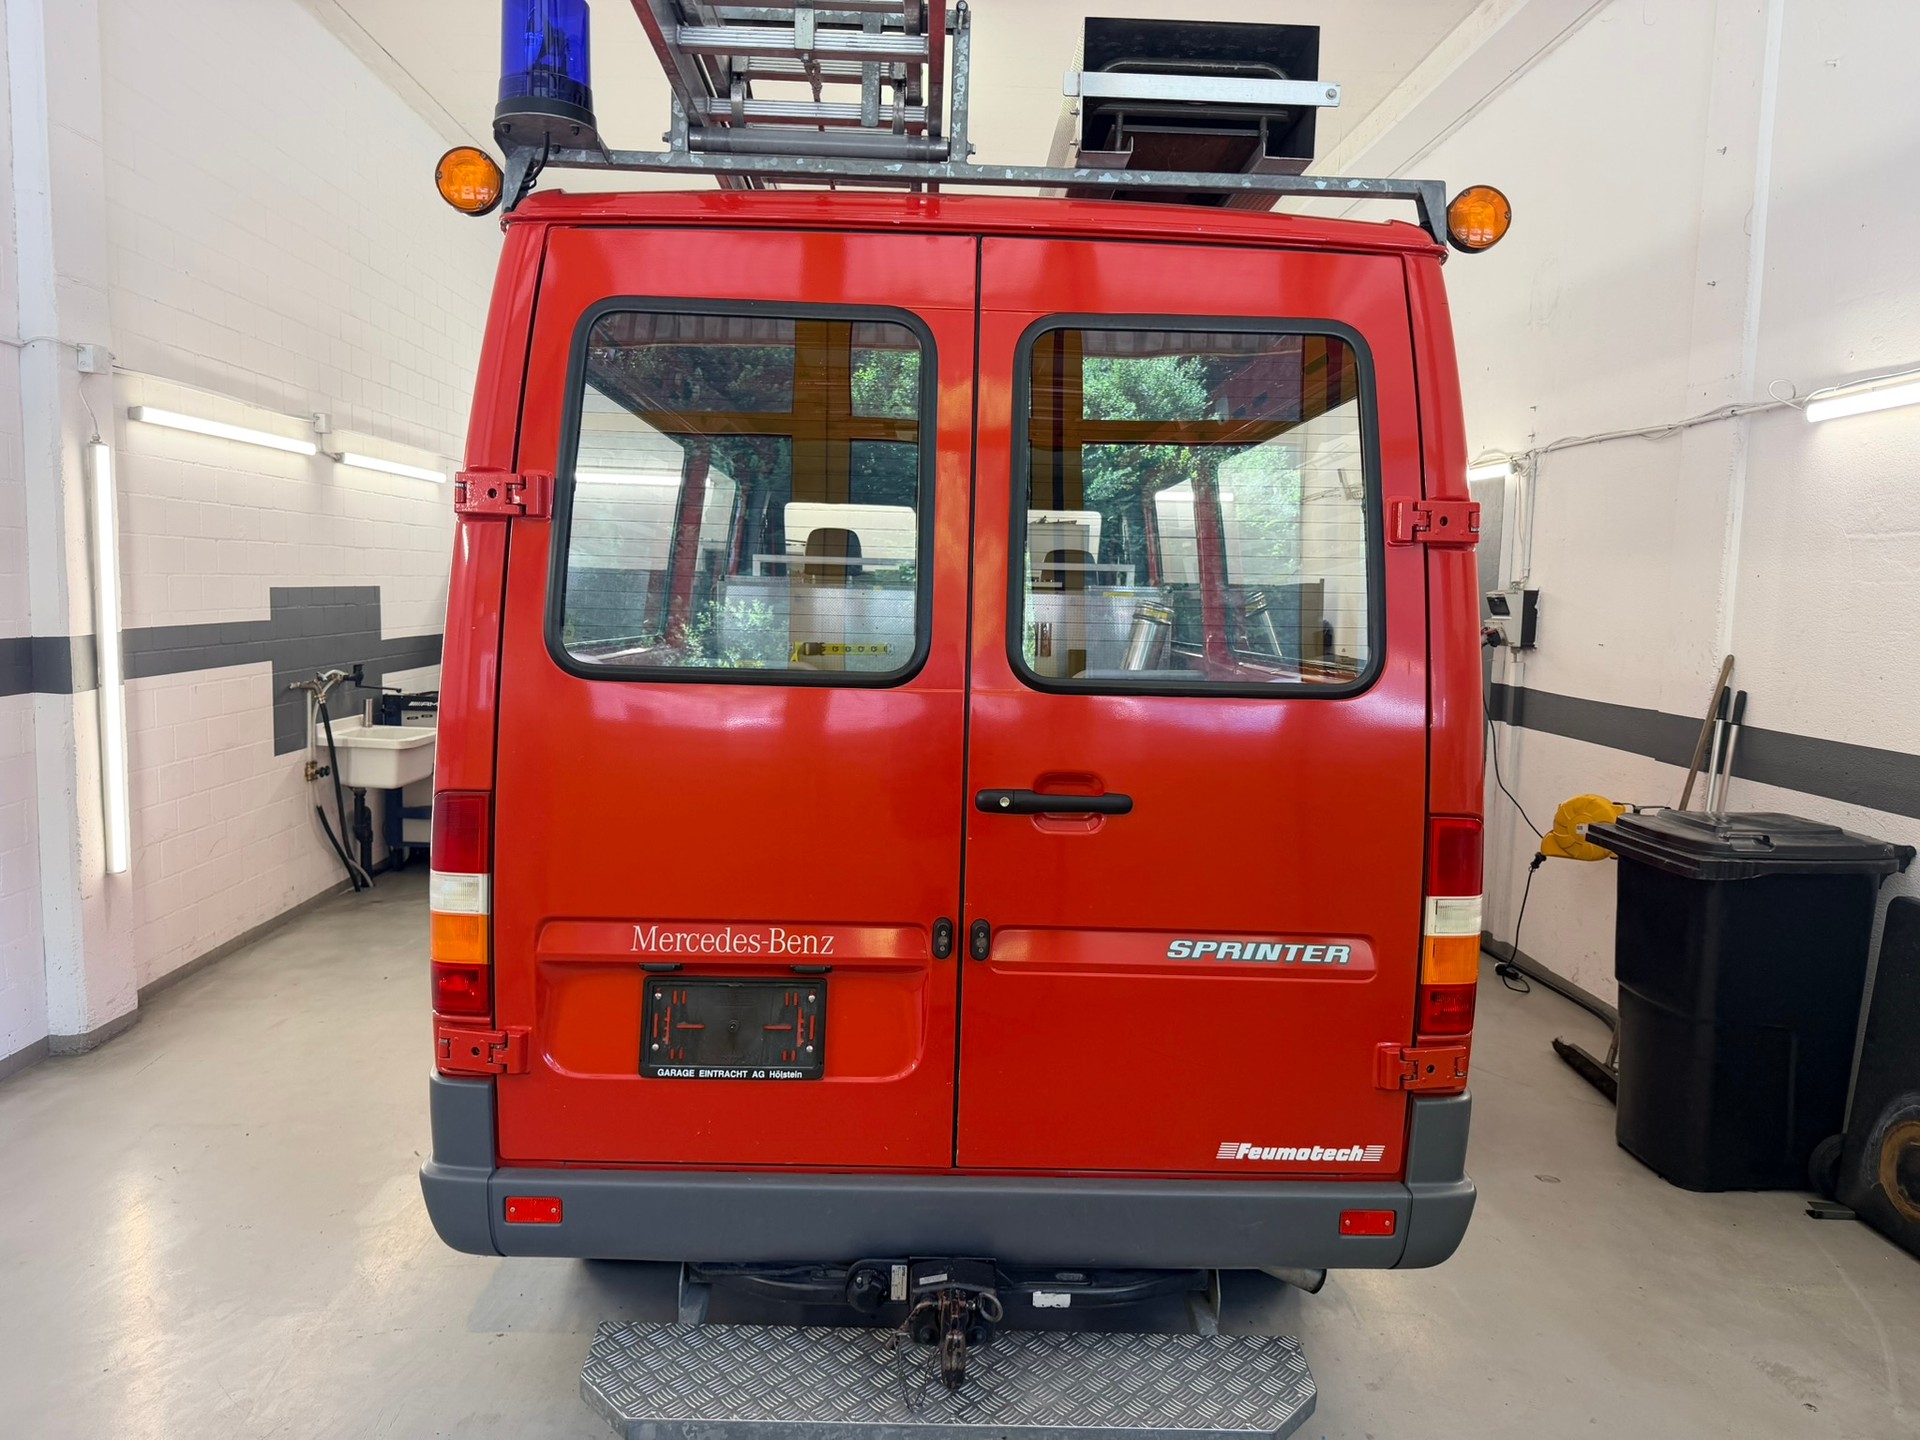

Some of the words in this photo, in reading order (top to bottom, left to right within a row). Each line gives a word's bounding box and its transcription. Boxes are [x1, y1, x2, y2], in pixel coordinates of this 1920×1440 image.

[630, 925, 834, 955] Mercedes-Benz
[1166, 939, 1351, 965] SPRINTER
[657, 1068, 695, 1077] GARAGE
[699, 1069, 748, 1078] EINTRACHT
[752, 1070, 765, 1078] AG
[1235, 1143, 1365, 1162] Feumotech
